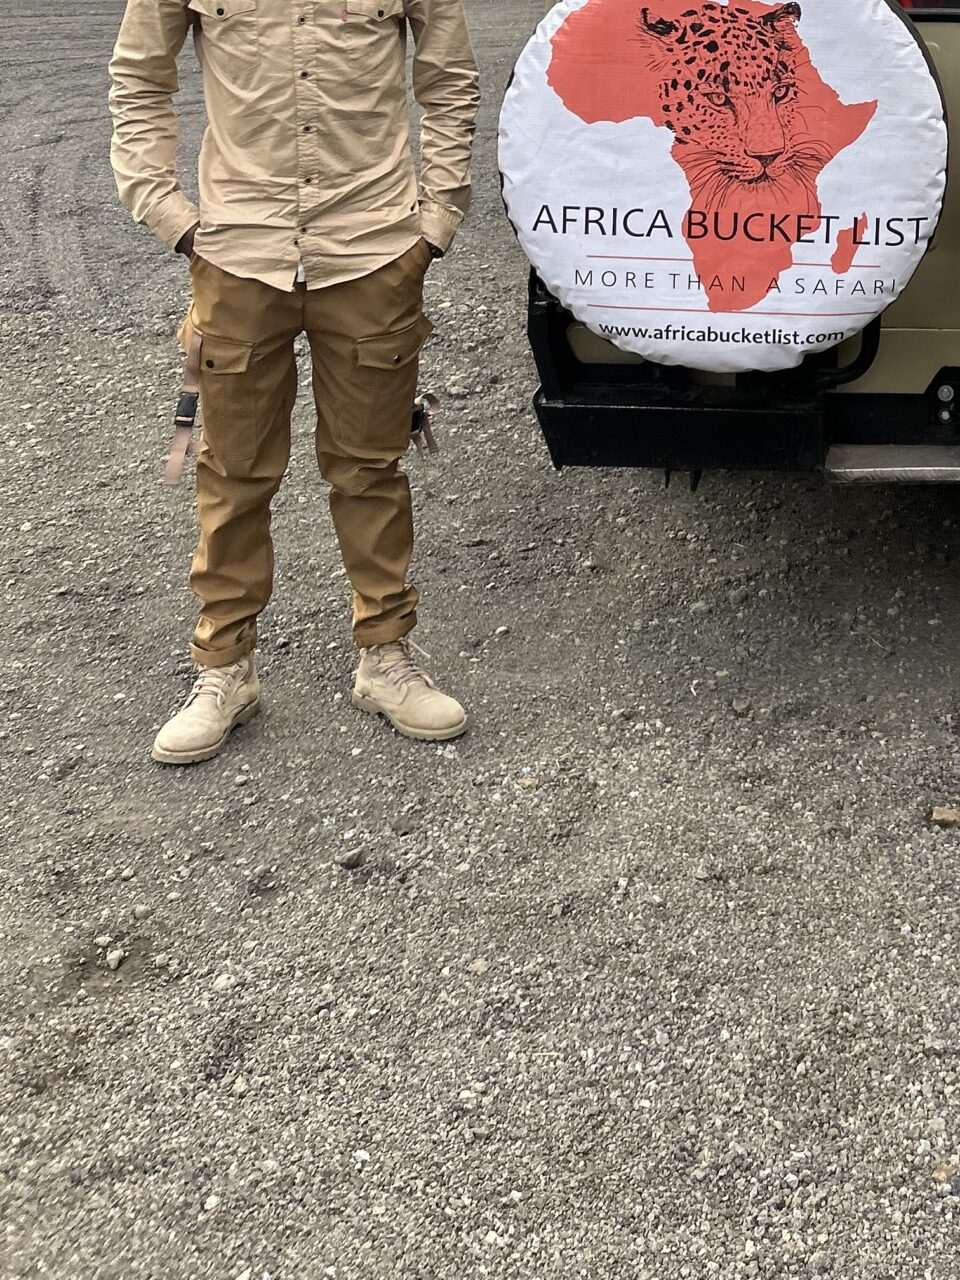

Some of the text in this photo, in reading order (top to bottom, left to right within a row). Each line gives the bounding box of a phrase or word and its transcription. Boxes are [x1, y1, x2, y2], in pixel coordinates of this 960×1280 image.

[532, 204, 928, 246] AFRICA BUCKET LIST
[574, 269, 896, 295] MORE THAN A SAFARI
[599, 323, 844, 345] www.africabucketlist.com
